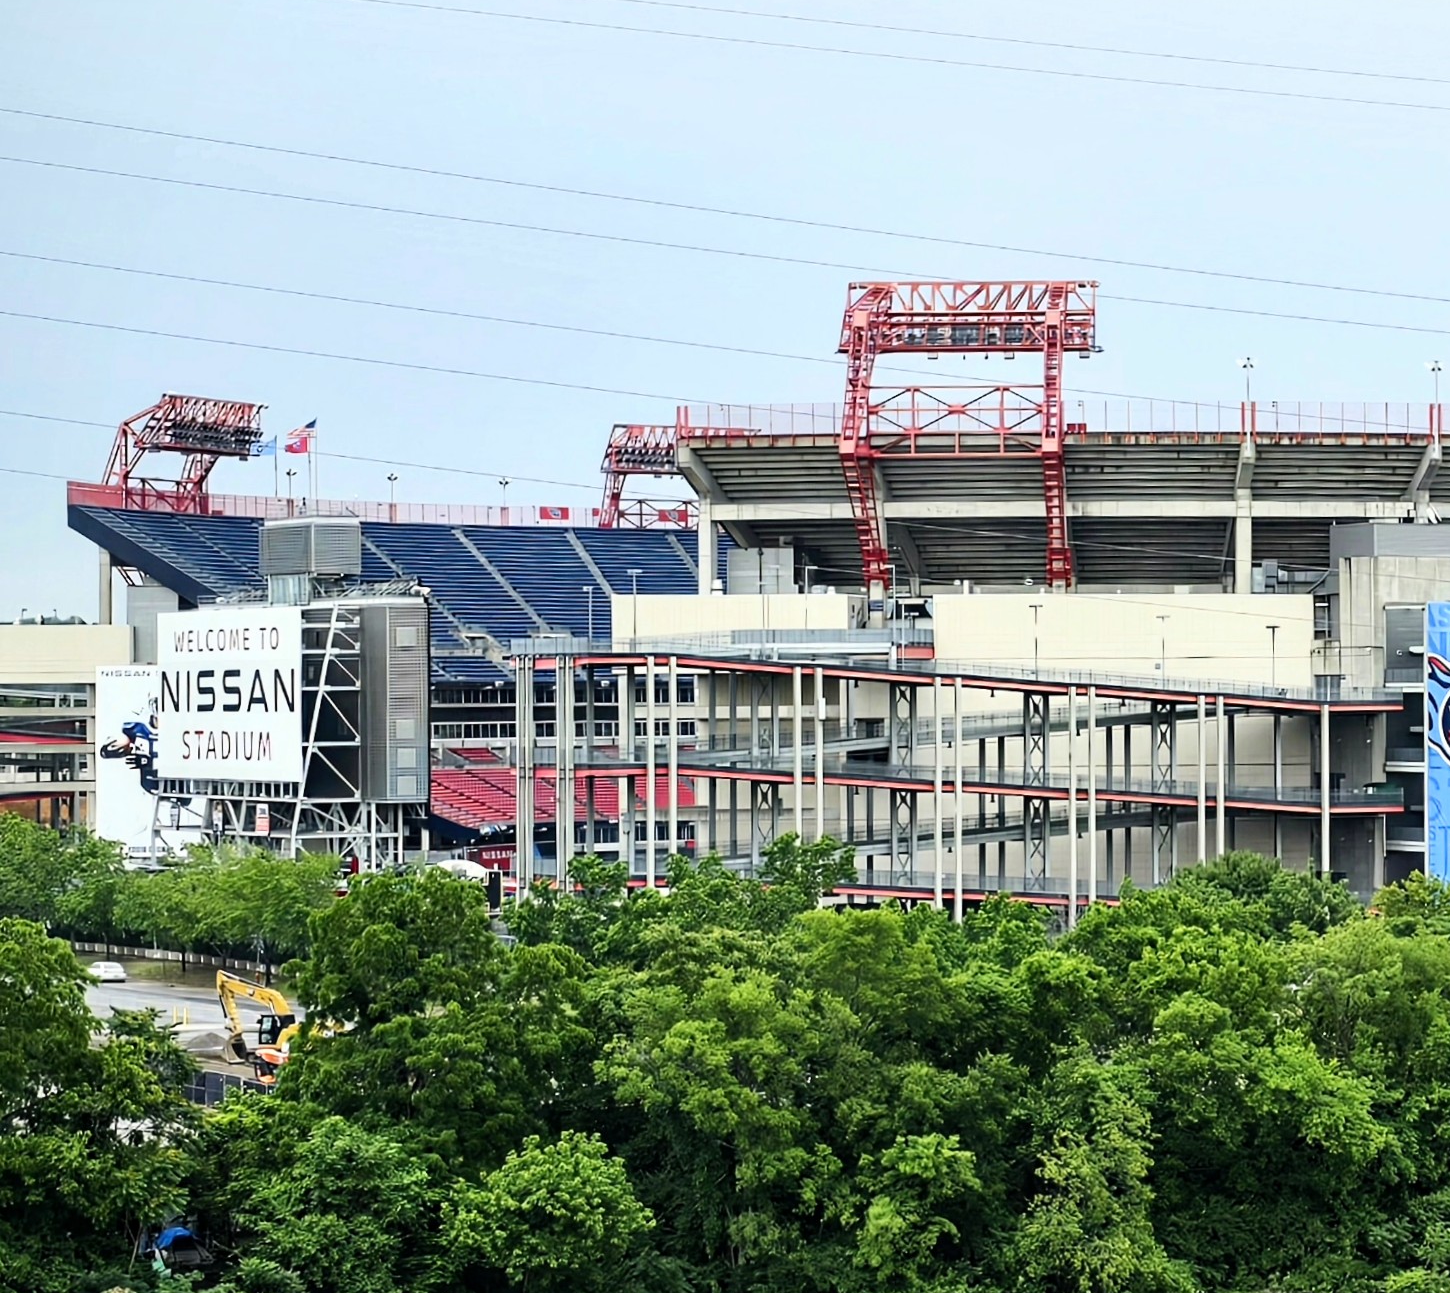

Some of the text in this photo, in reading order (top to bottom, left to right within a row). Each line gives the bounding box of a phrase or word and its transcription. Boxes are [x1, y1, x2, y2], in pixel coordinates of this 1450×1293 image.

[174, 627, 279, 653] WELCOME TO
[161, 668, 295, 713] NISSAN
[182, 730, 272, 760] STADIUM
